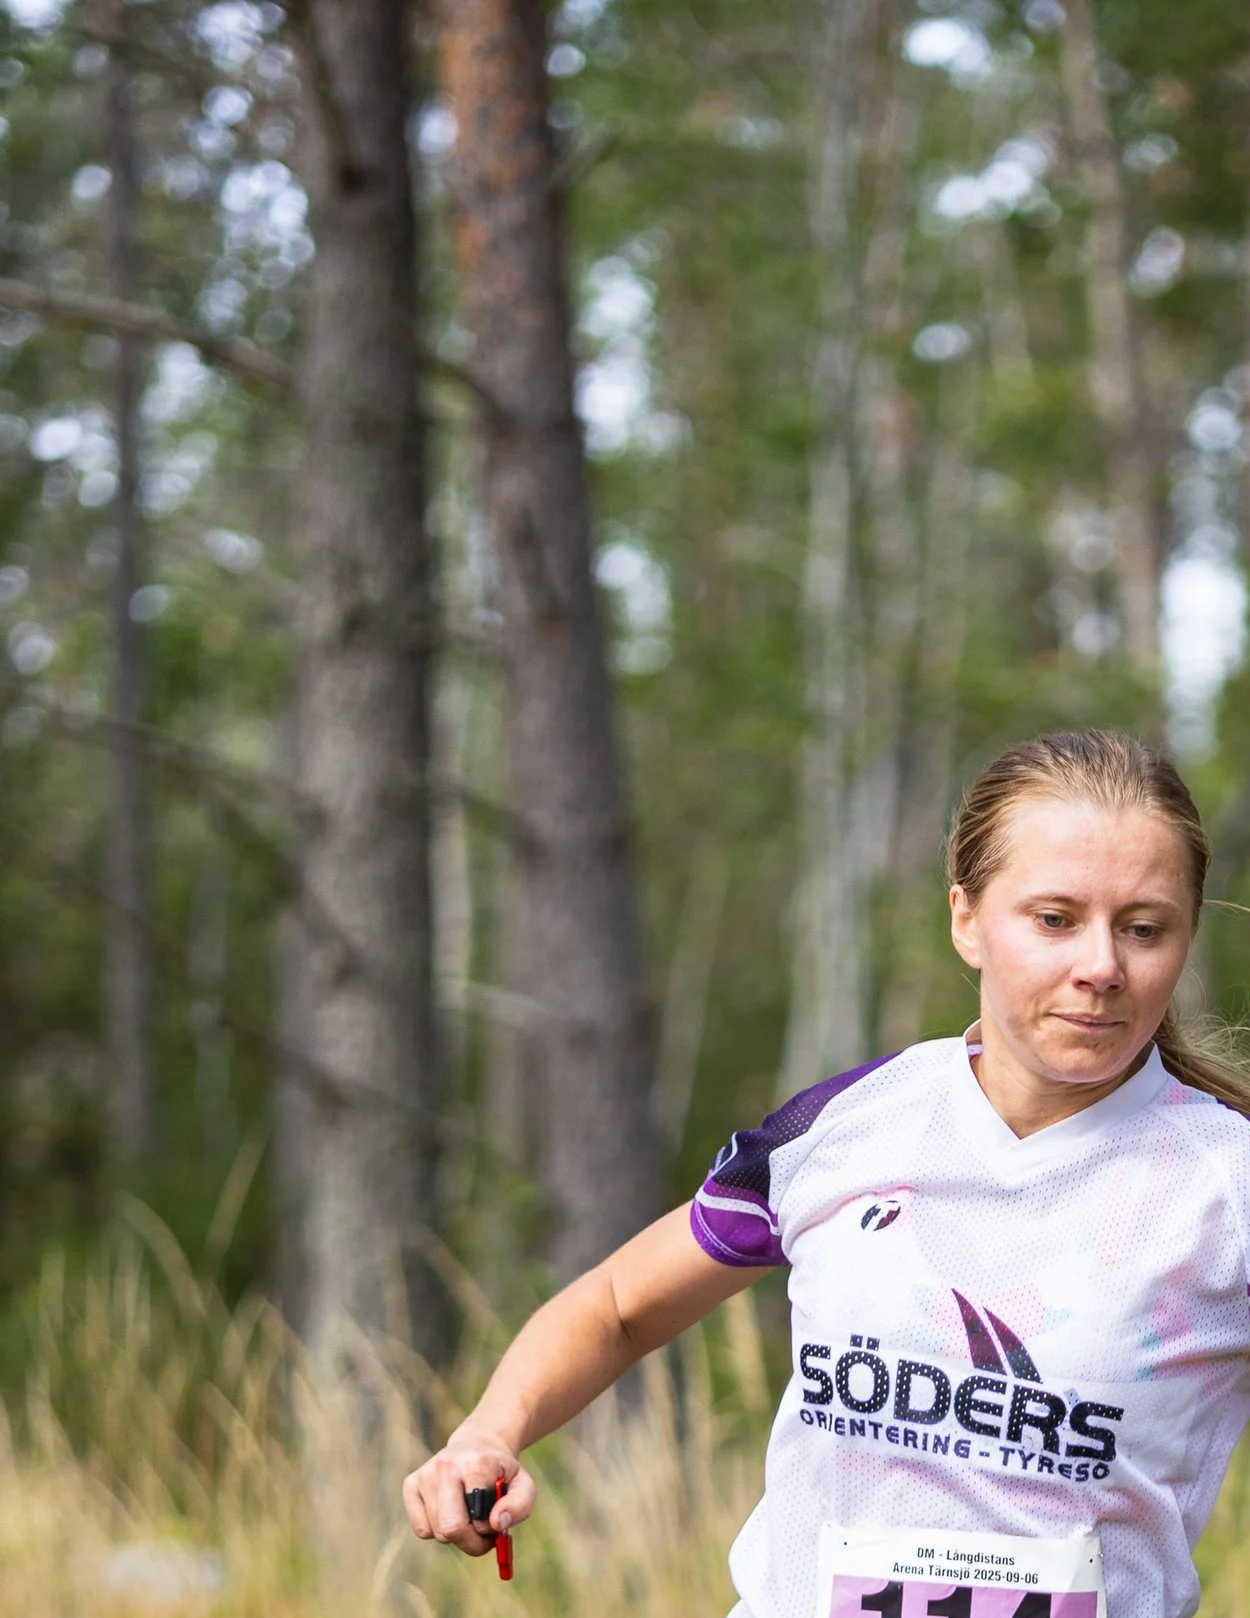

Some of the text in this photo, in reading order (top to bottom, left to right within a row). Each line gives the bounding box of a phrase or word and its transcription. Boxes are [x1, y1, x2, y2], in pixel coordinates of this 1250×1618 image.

[800, 1334, 1124, 1462] SÖDERS
[799, 1407, 971, 1458] ORIENTERING
[892, 1561, 1039, 1585] Arena Tärnsjö 2025-09-06
[916, 1546, 935, 1559] DM
[946, 1548, 1015, 1566] Långdistans
